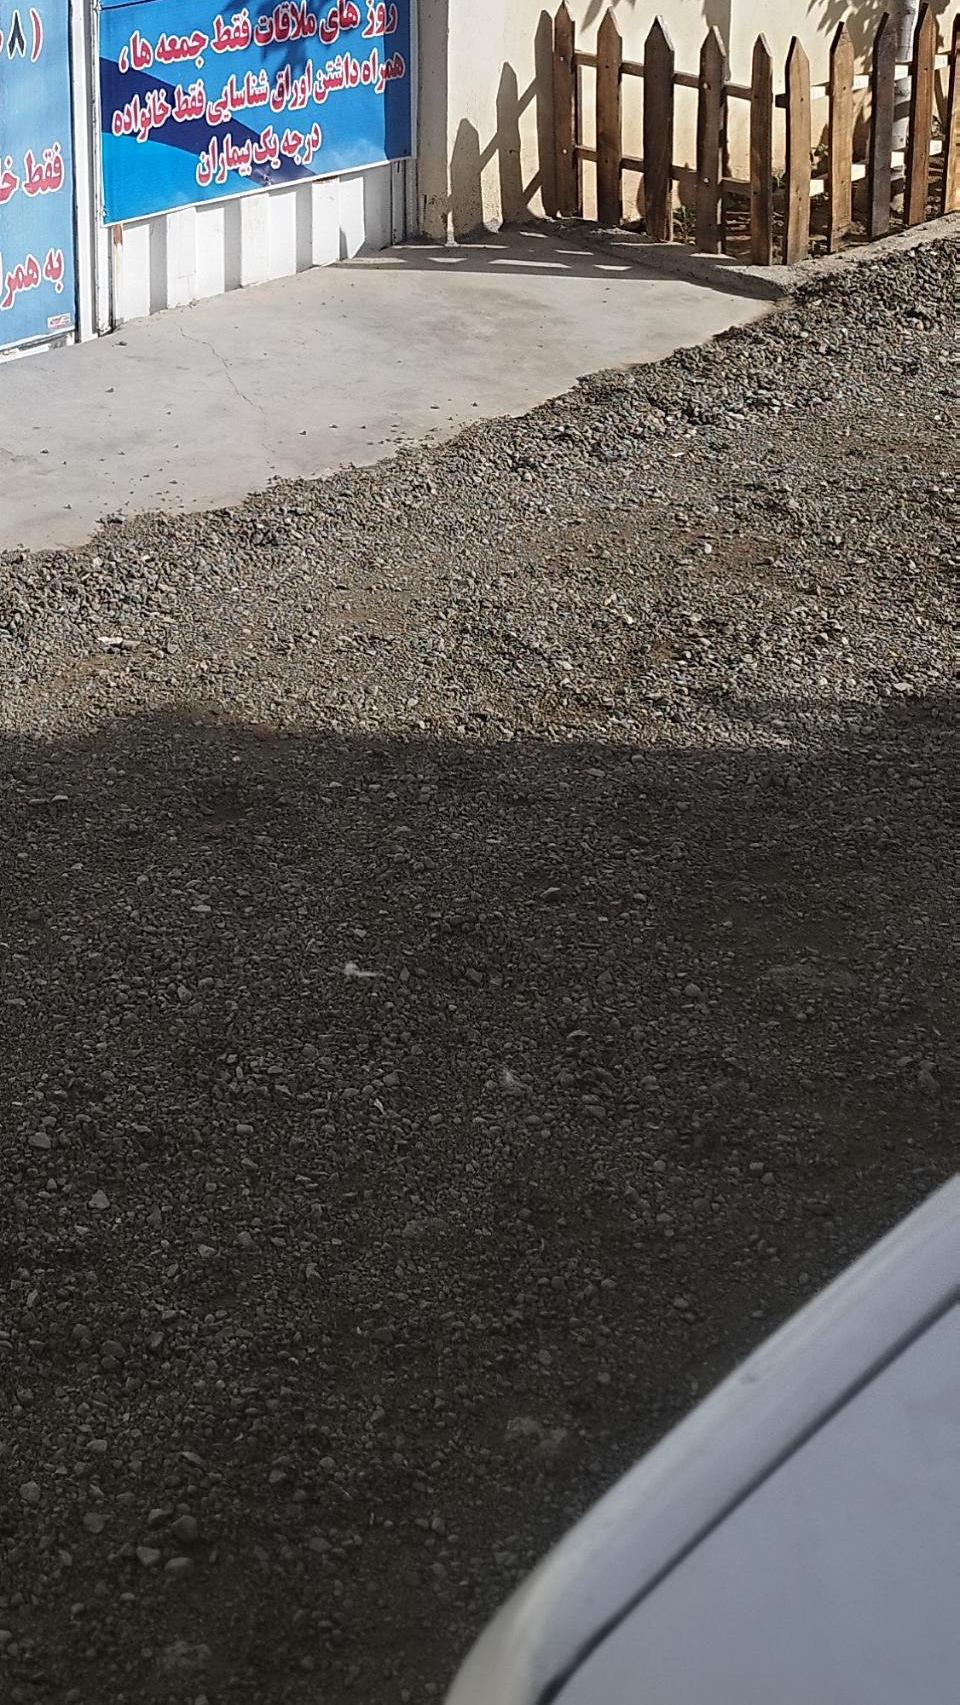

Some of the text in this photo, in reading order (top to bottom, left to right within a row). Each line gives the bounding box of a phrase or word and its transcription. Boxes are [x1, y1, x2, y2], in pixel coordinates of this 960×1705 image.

[211, 8, 252, 54] فقط
[254, 0, 317, 46] ملاقات
[155, 28, 209, 69] جمعه
[360, 48, 405, 94] همراه
[271, 61, 313, 112] اوراق
[313, 52, 359, 103] داشتن
[112, 88, 171, 142] خانواده
[173, 79, 206, 123] فقط
[196, 135, 253, 185] بیماران
[281, 122, 322, 166] درجه
[22, 143, 64, 196] فقط
[42, 247, 65, 292] به
